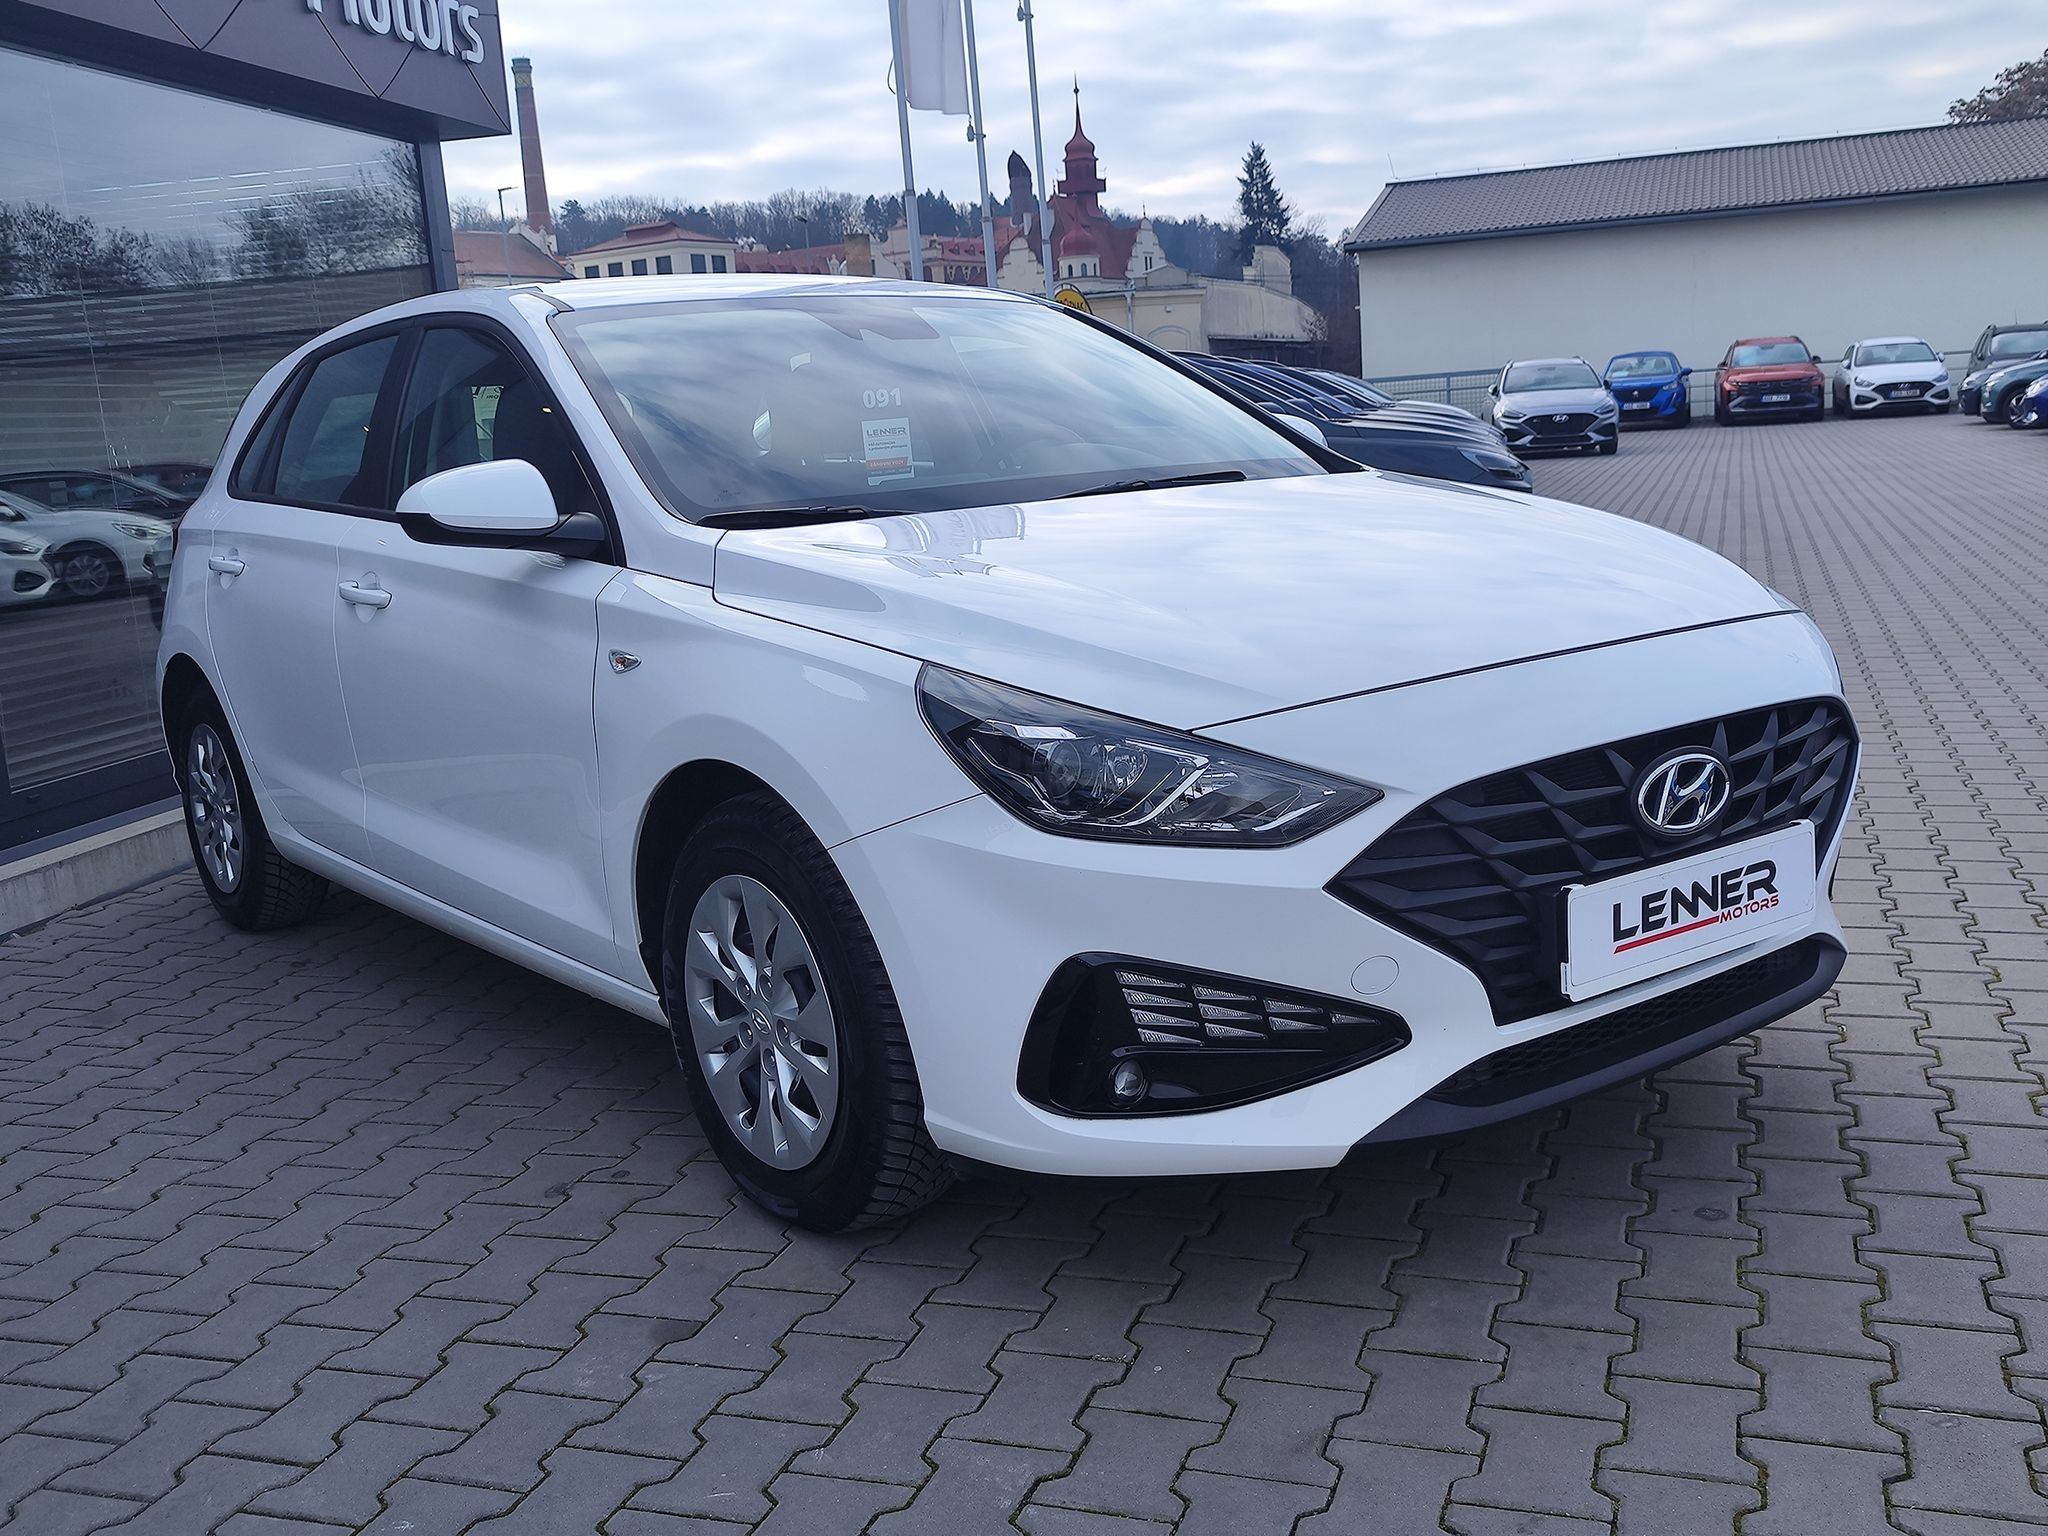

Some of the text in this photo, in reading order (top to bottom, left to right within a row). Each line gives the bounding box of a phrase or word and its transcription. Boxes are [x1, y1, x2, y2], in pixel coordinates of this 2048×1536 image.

[306, 0, 485, 64] otors
[863, 388, 902, 409] 091
[866, 426, 907, 437] LENNER
[1613, 859, 1779, 943] LENNER
[1719, 894, 1780, 924] MOTORS
